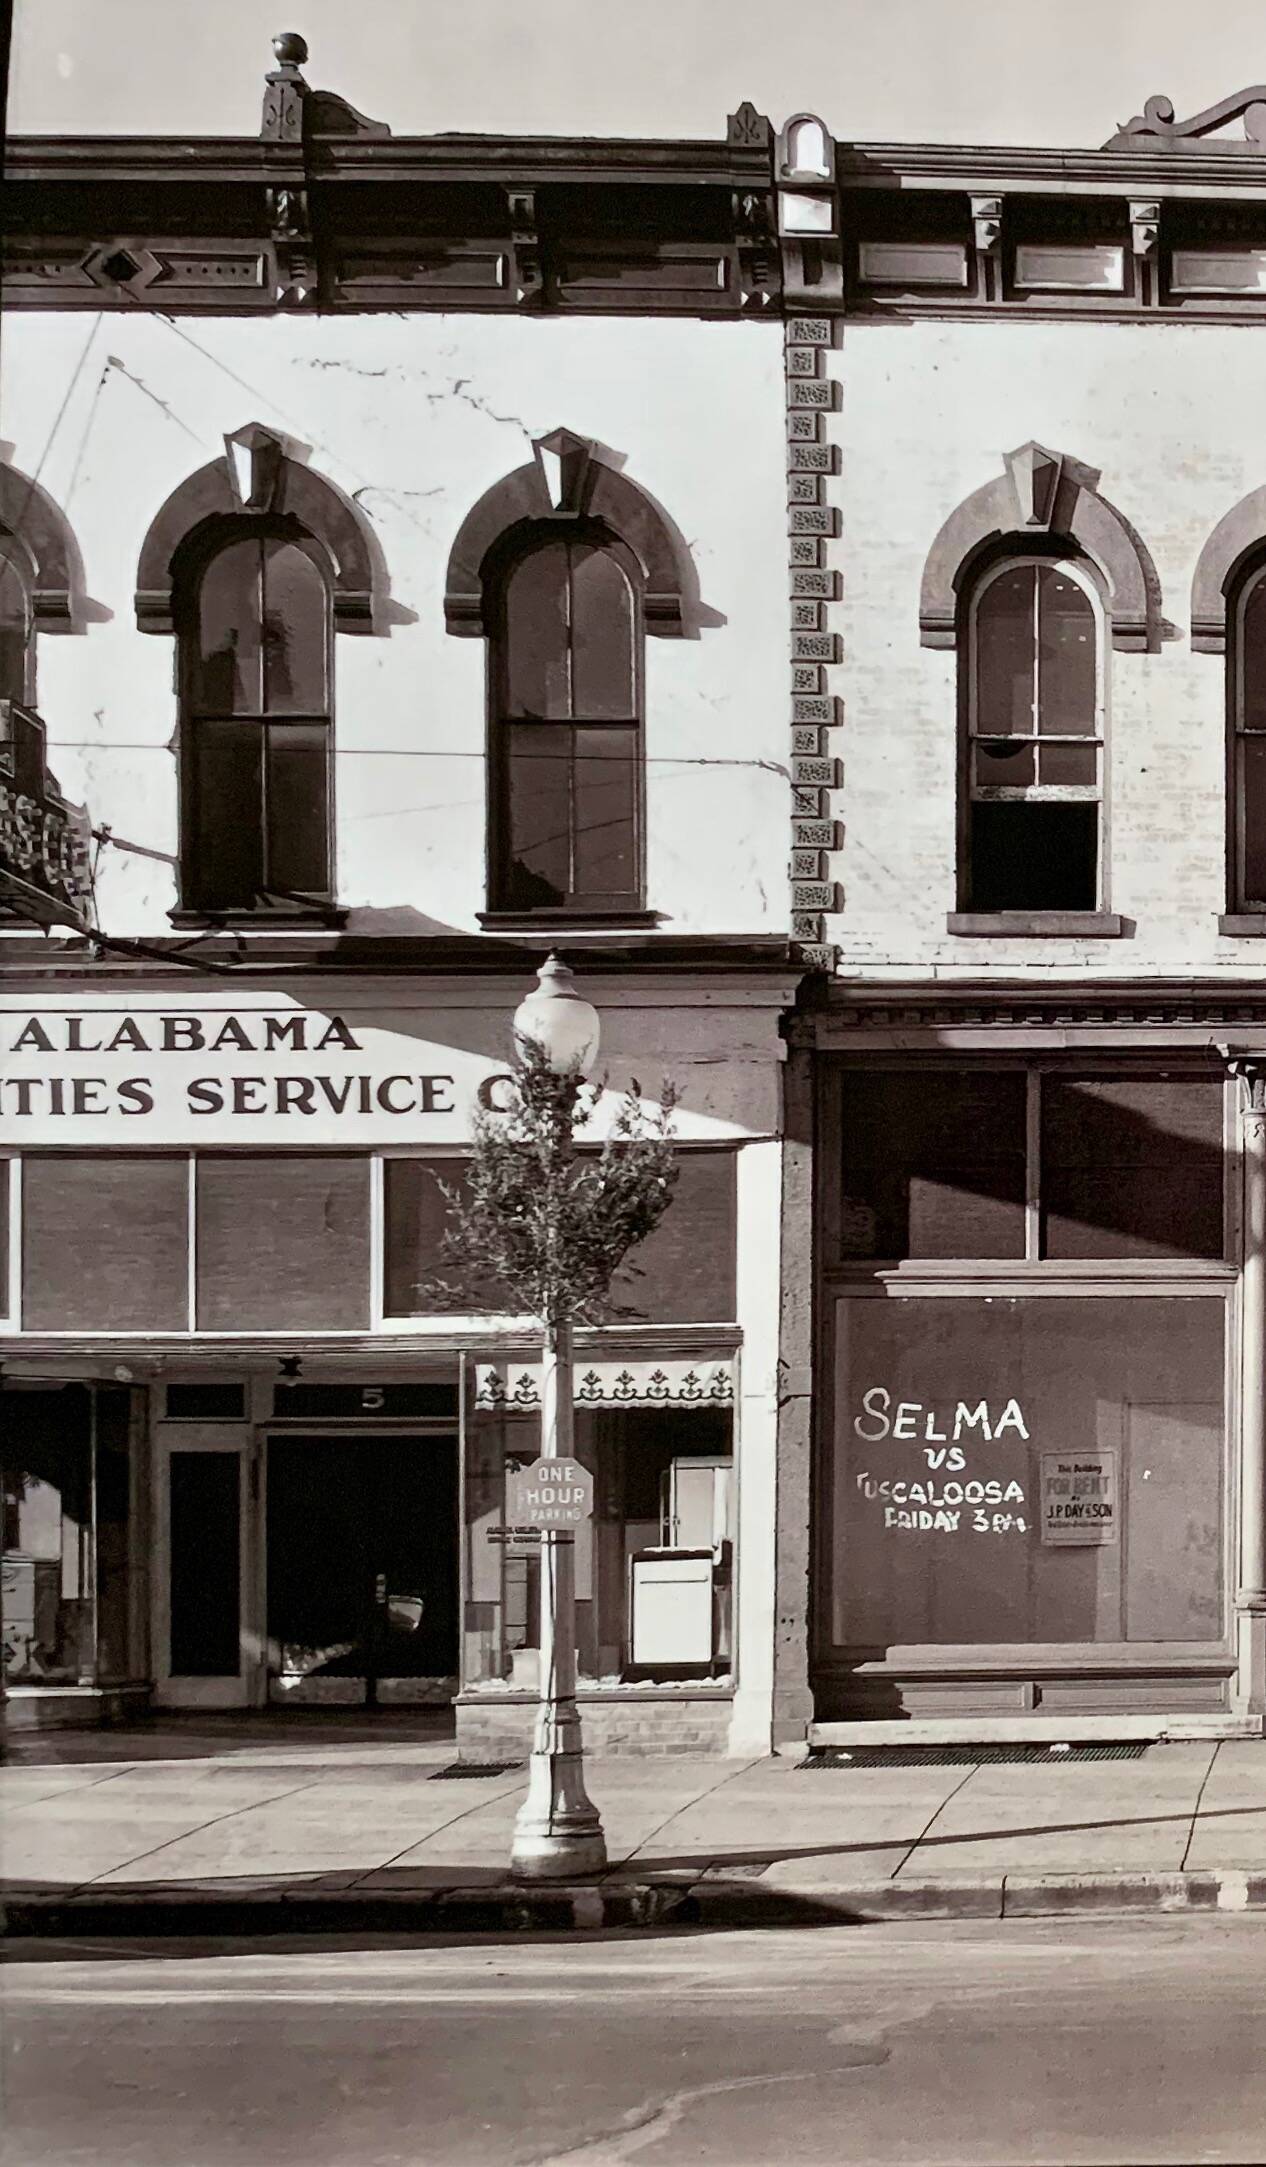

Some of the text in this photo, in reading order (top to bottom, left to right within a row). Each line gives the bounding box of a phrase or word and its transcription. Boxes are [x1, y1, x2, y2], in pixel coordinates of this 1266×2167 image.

[9, 1016, 364, 1052] ALABAMA
[0, 1077, 154, 1116] TIES
[186, 1075, 456, 1116] SERVICE
[362, 1388, 385, 1409] 5
[854, 1387, 1031, 1441] SELMA
[538, 1466, 576, 1482] ONE
[527, 1487, 585, 1505] HOUR
[856, 1472, 1025, 1507] TUSCALOOSA
[1046, 1476, 1109, 1496] FOR RENT
[530, 1508, 582, 1521] PARKING
[884, 1507, 961, 1533] FRIDAY
